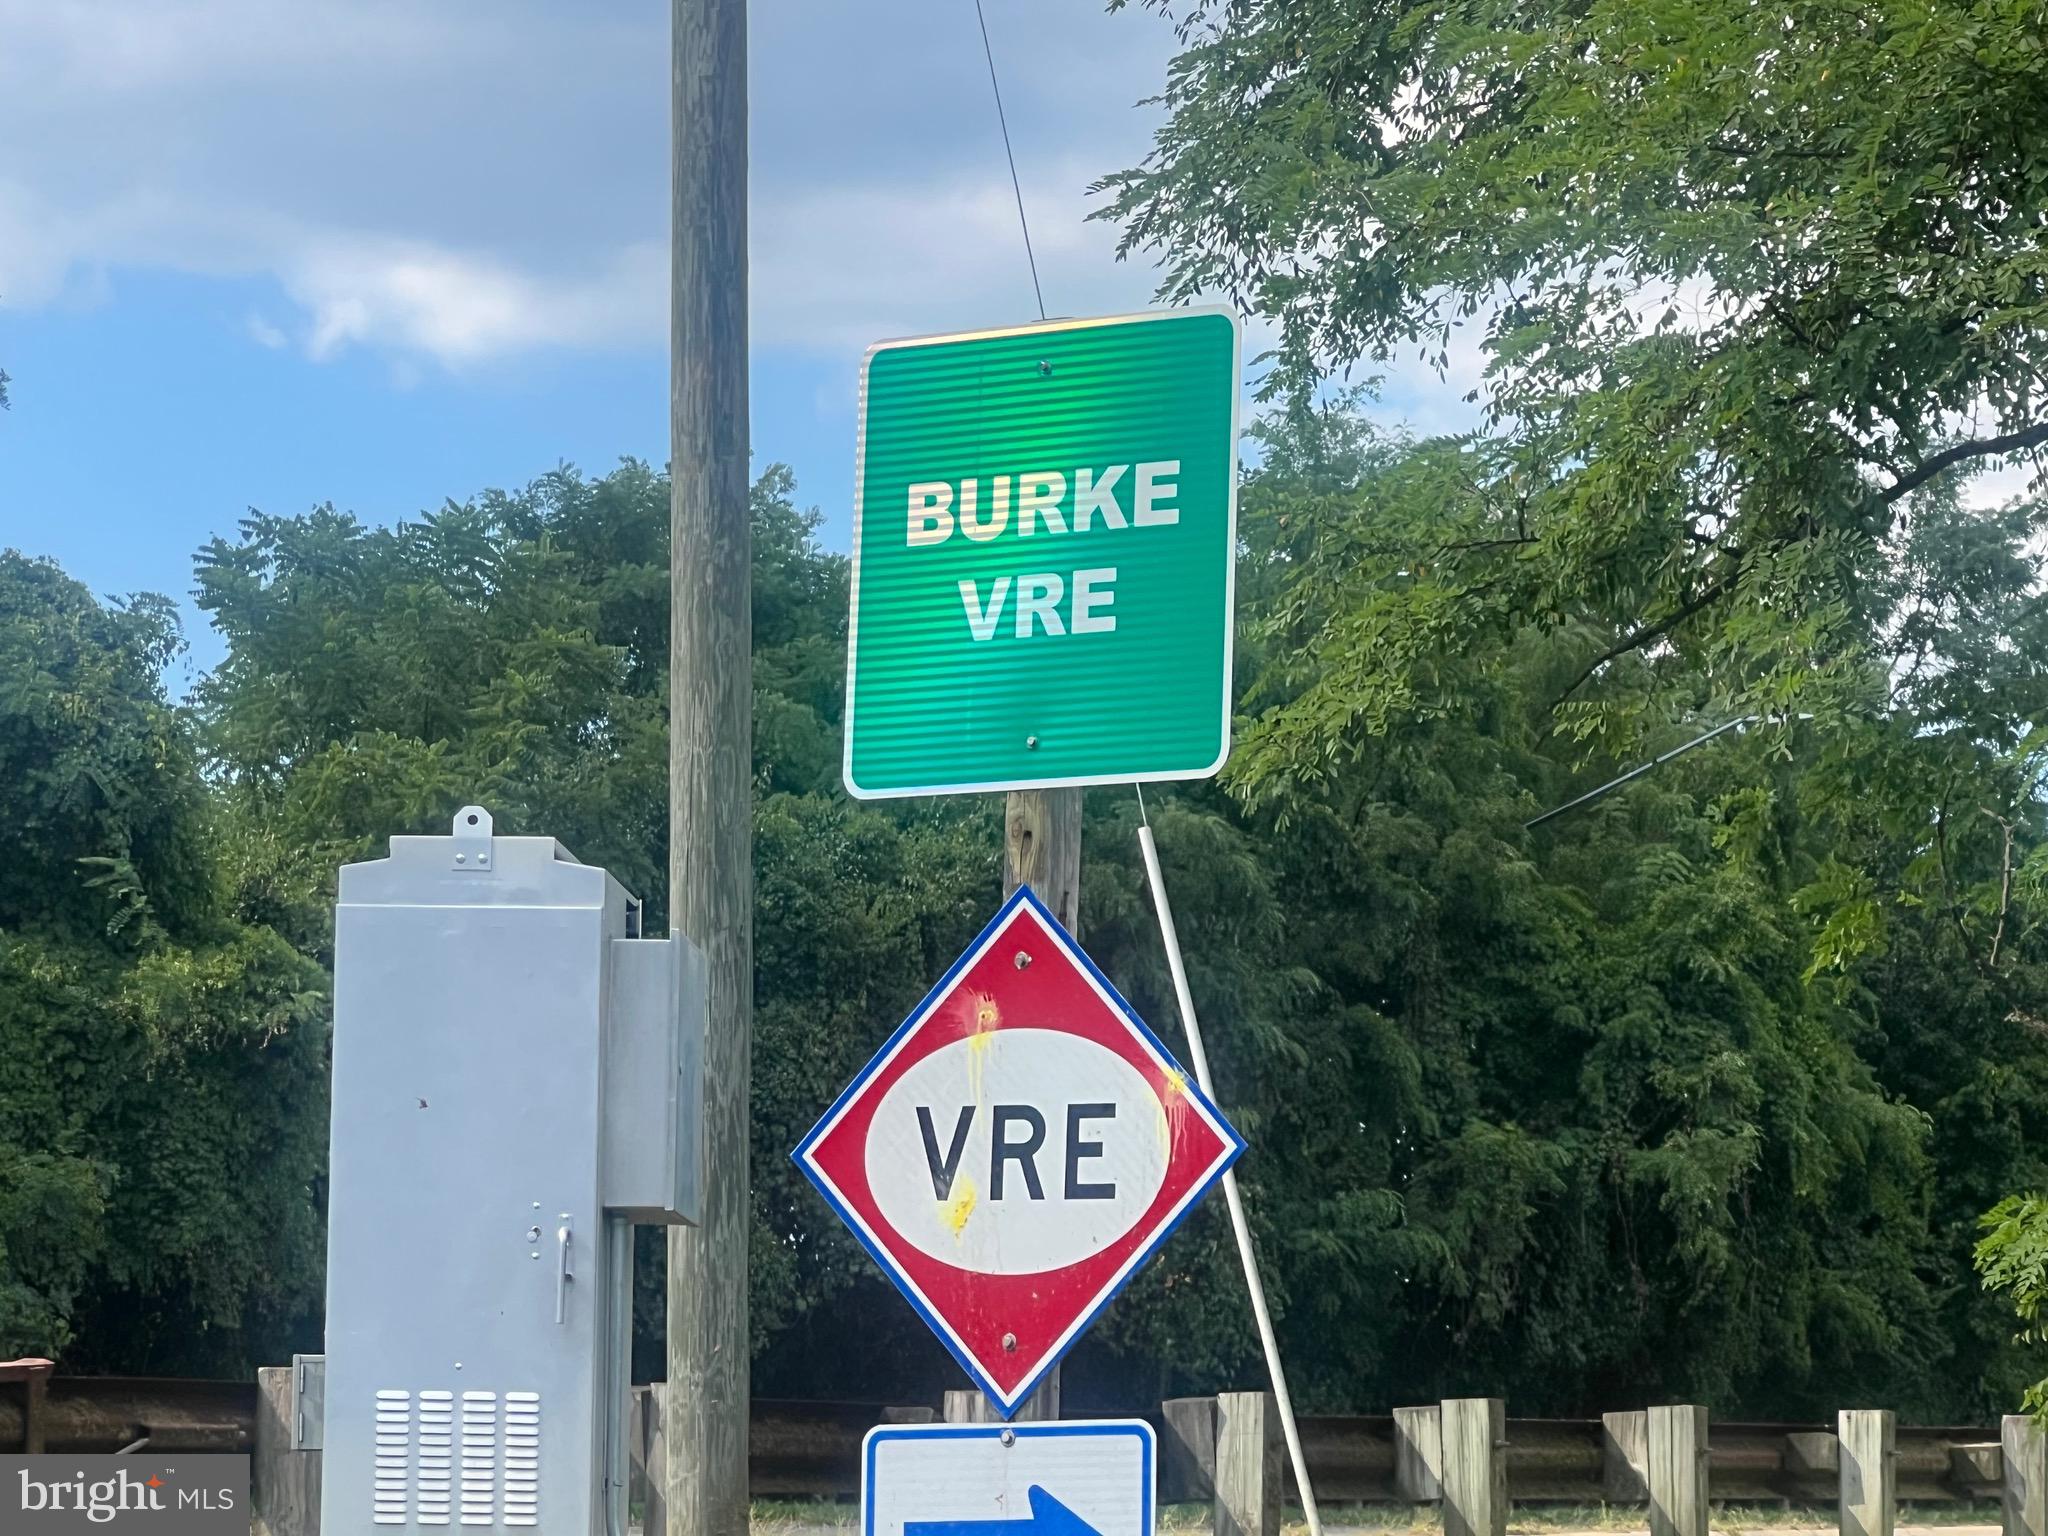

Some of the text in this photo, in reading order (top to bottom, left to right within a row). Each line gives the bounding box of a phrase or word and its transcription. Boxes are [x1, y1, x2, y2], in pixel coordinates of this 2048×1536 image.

[906, 459, 1181, 547] BURKE
[958, 567, 1117, 642] VRE
[915, 1103, 1117, 1201] VRE
